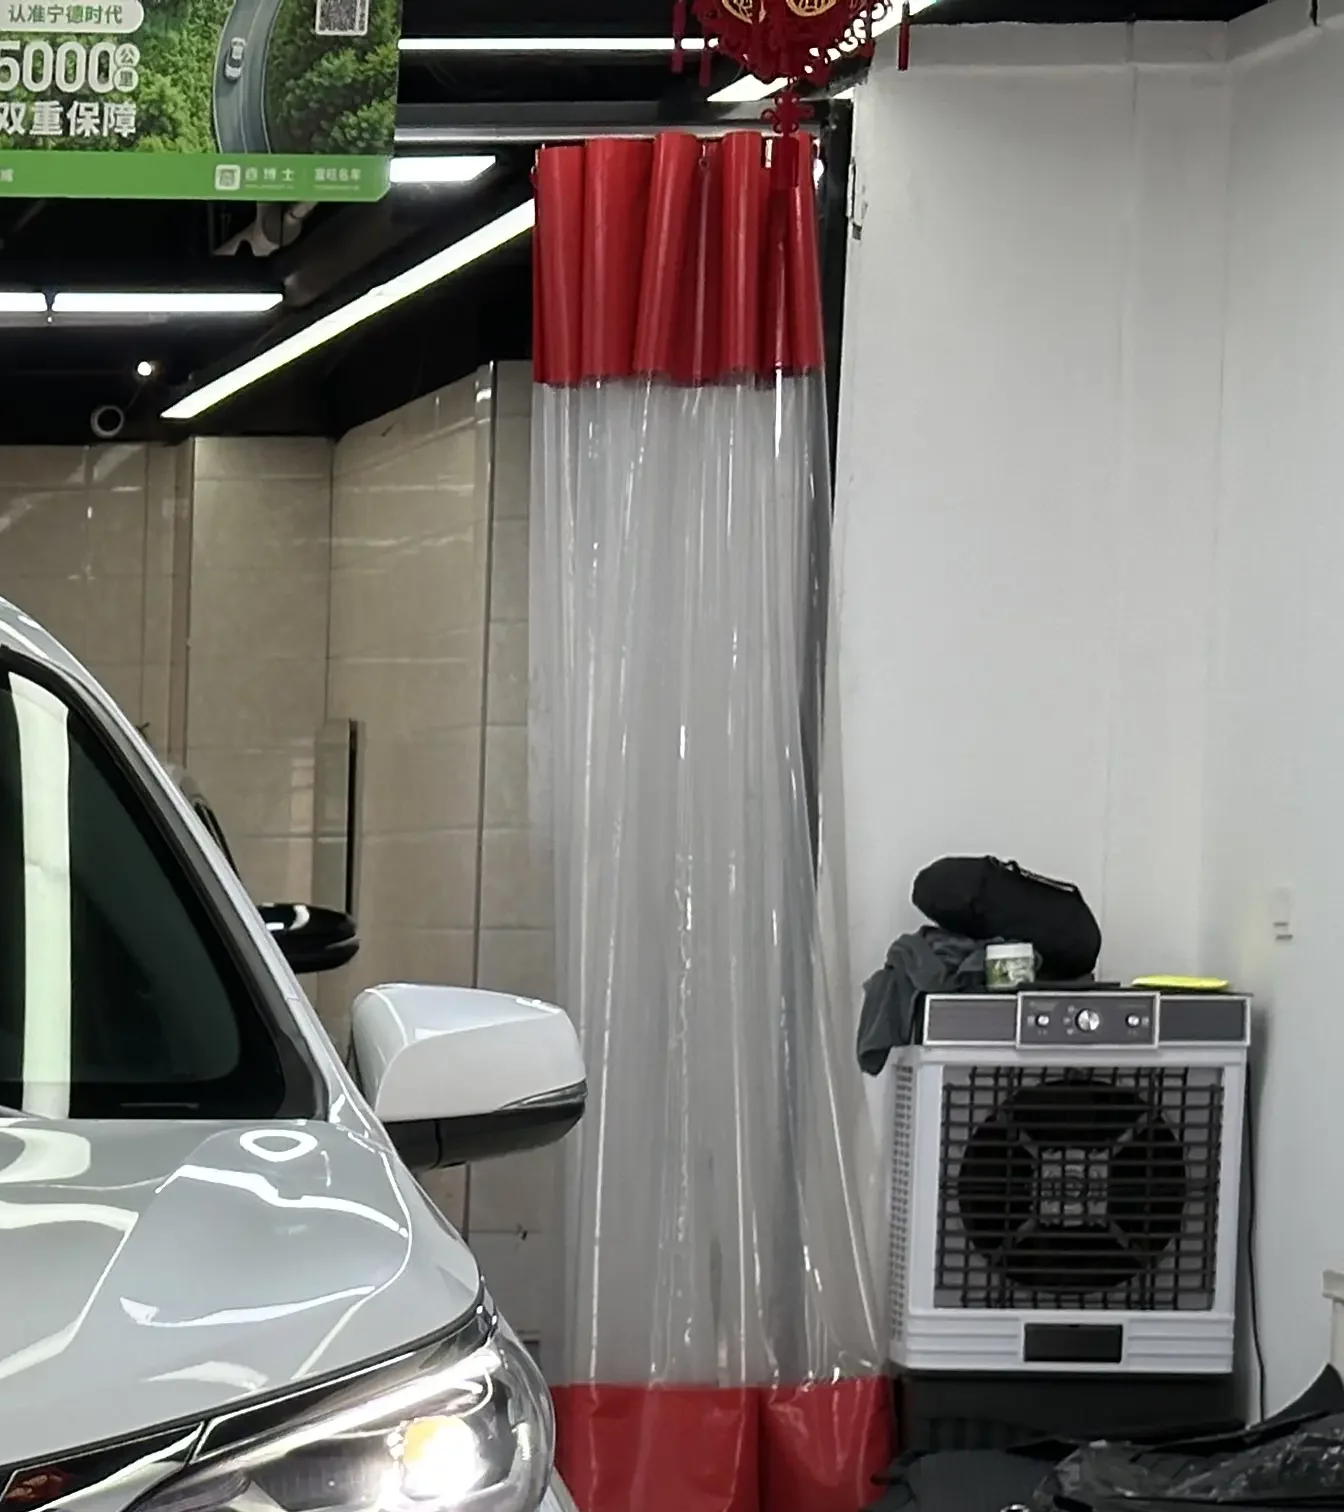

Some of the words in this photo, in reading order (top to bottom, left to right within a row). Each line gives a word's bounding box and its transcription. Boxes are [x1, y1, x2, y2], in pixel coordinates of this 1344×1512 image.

[8, 4, 123, 25] 认准宁德时代
